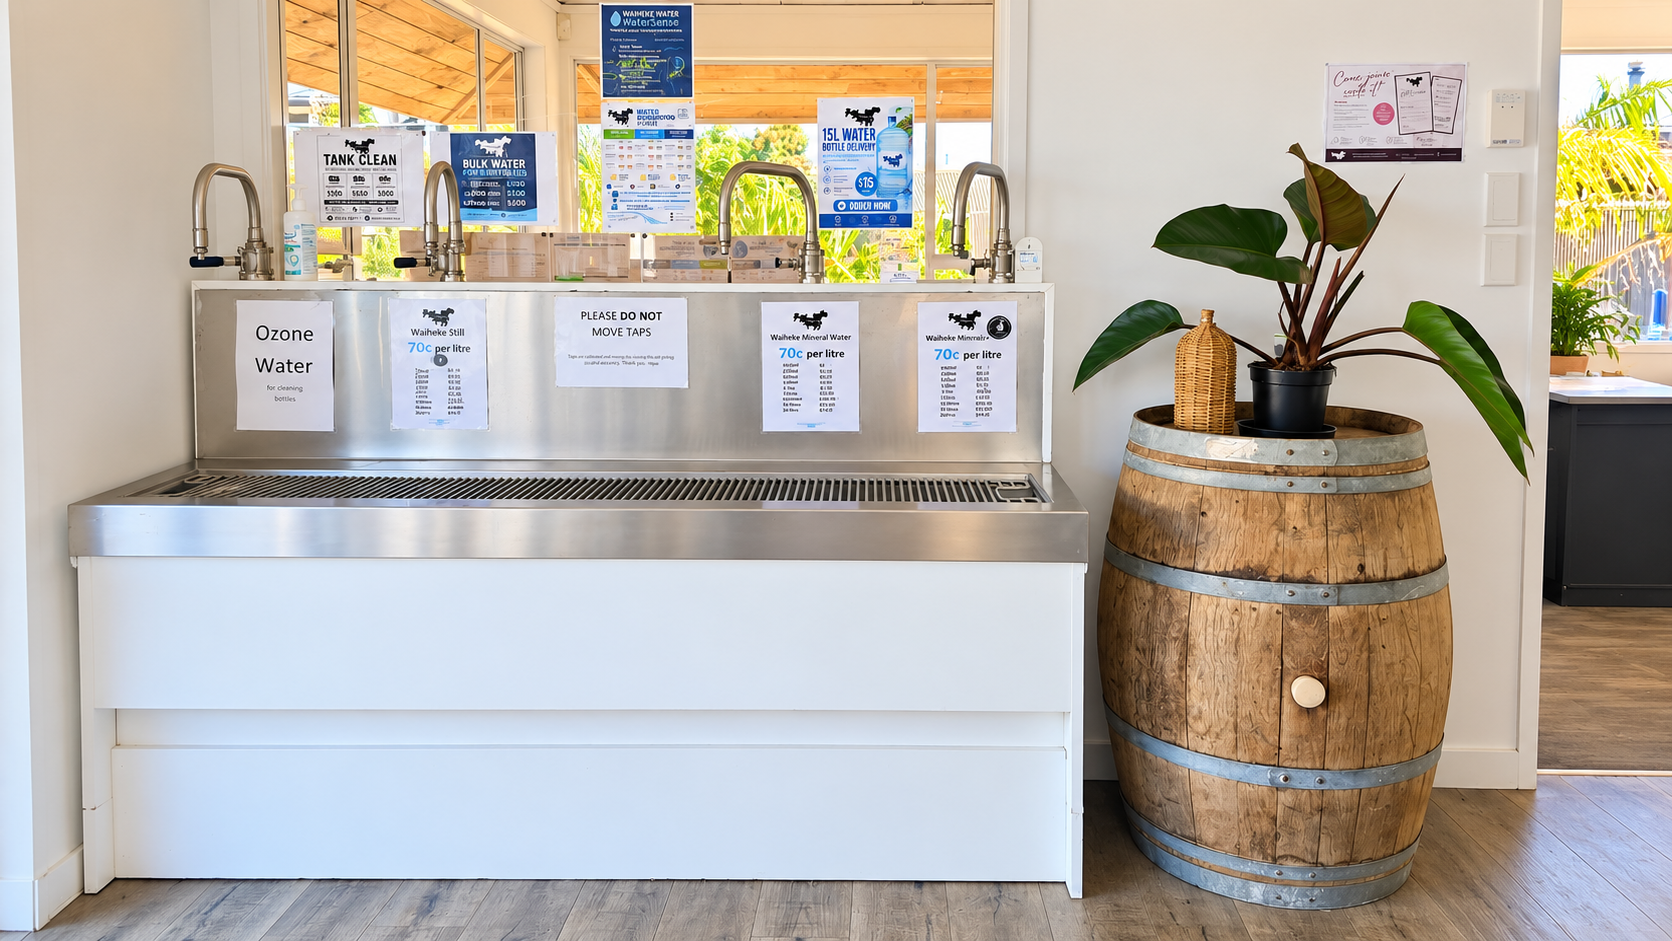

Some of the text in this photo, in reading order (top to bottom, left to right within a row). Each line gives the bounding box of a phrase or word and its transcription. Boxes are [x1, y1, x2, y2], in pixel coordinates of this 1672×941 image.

[822, 128, 876, 141] 15L WATER
[822, 143, 845, 152] BOTTLE
[323, 154, 397, 166] TANK CLEAN
[463, 159, 526, 169] BULK WATER
[581, 311, 663, 321] PLEASE DO NOT
[256, 325, 314, 342] Ozone
[411, 328, 465, 337] Waiheke Still
[592, 327, 652, 337] MOVE TAPS
[408, 342, 471, 355] 70c per litre
[779, 347, 845, 360] 70c per litre
[934, 348, 1002, 361] 70c per litre
[255, 357, 313, 374] Water
[277, 384, 303, 392] cleaning
